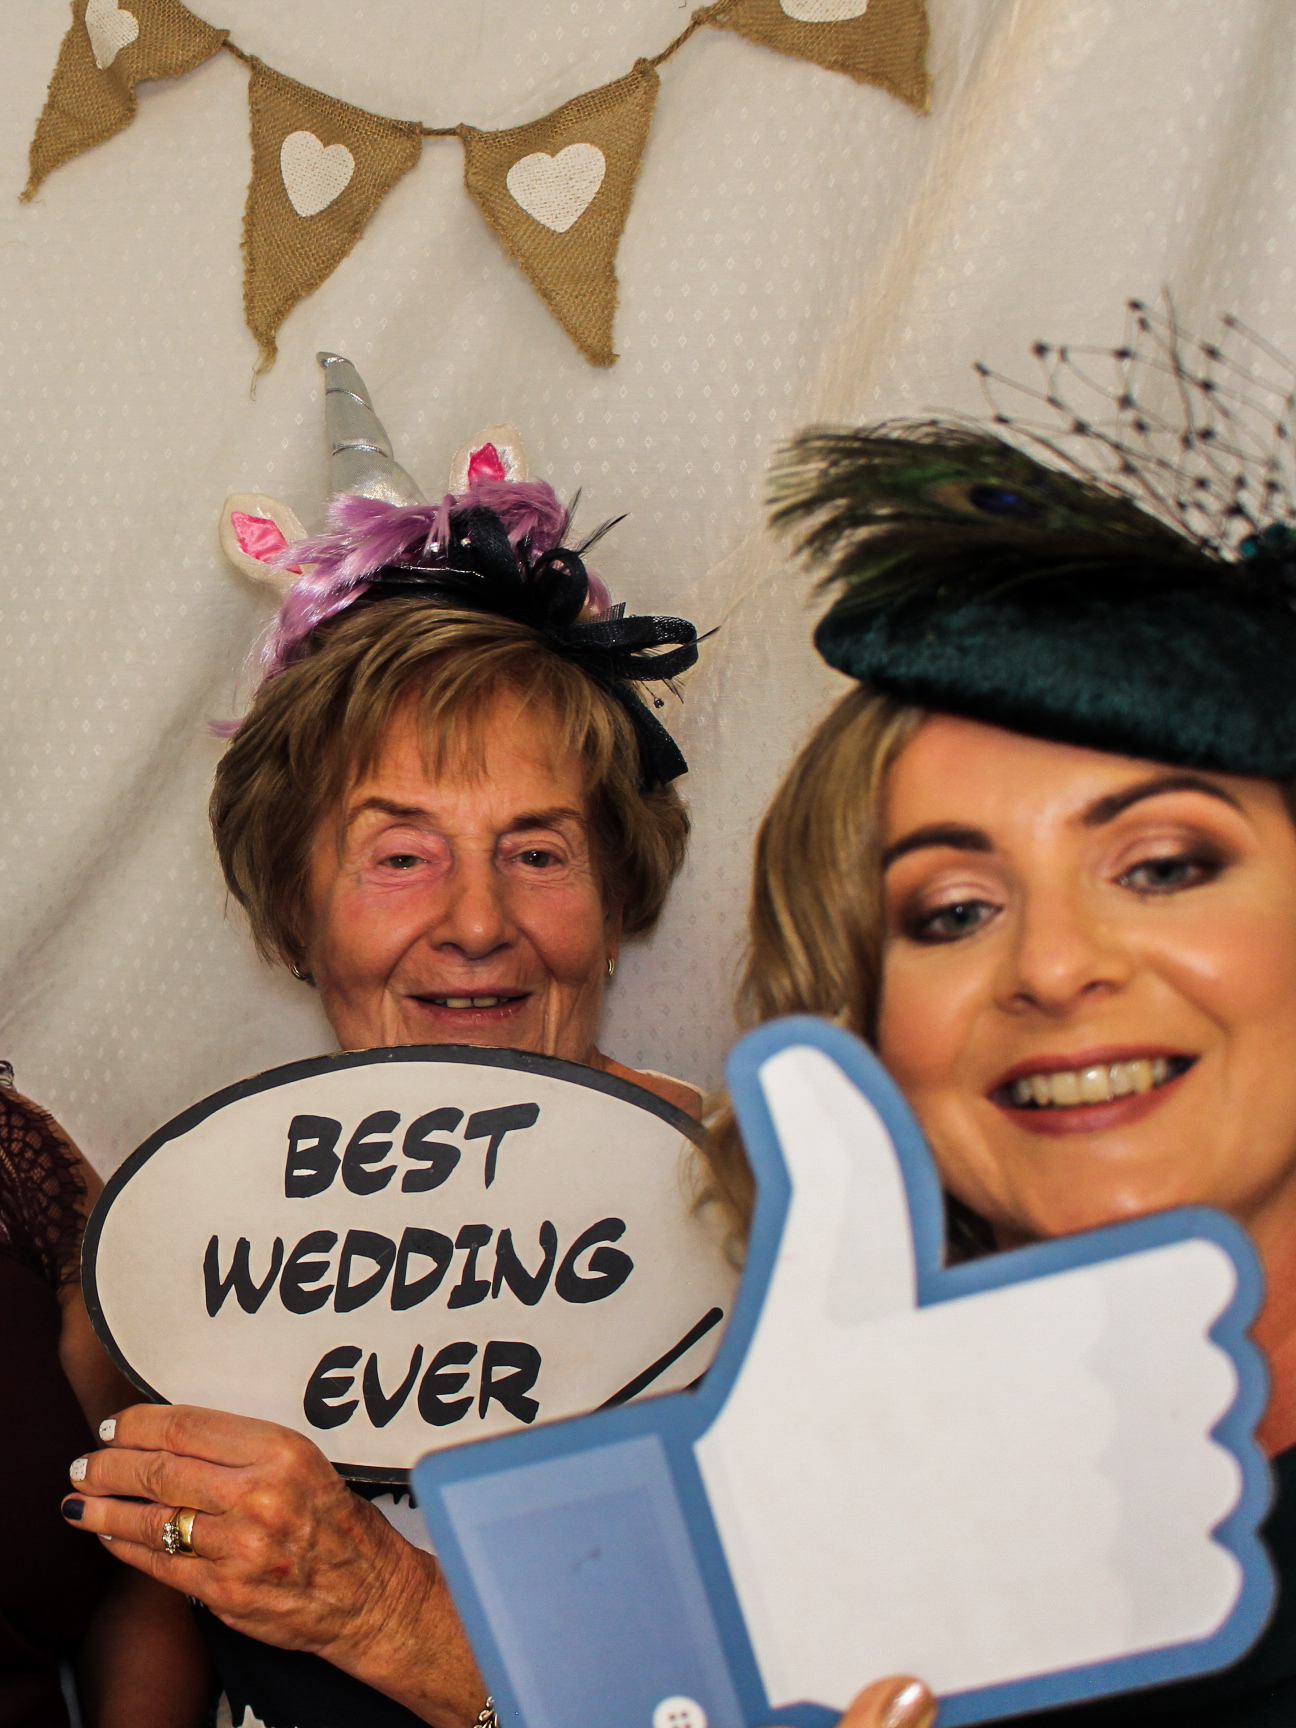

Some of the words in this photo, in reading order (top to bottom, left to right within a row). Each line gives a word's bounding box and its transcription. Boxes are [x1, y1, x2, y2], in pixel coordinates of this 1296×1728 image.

[284, 1101, 541, 1199] BEST
[203, 1217, 635, 1317] WEDDING
[303, 1340, 542, 1430] EVER
